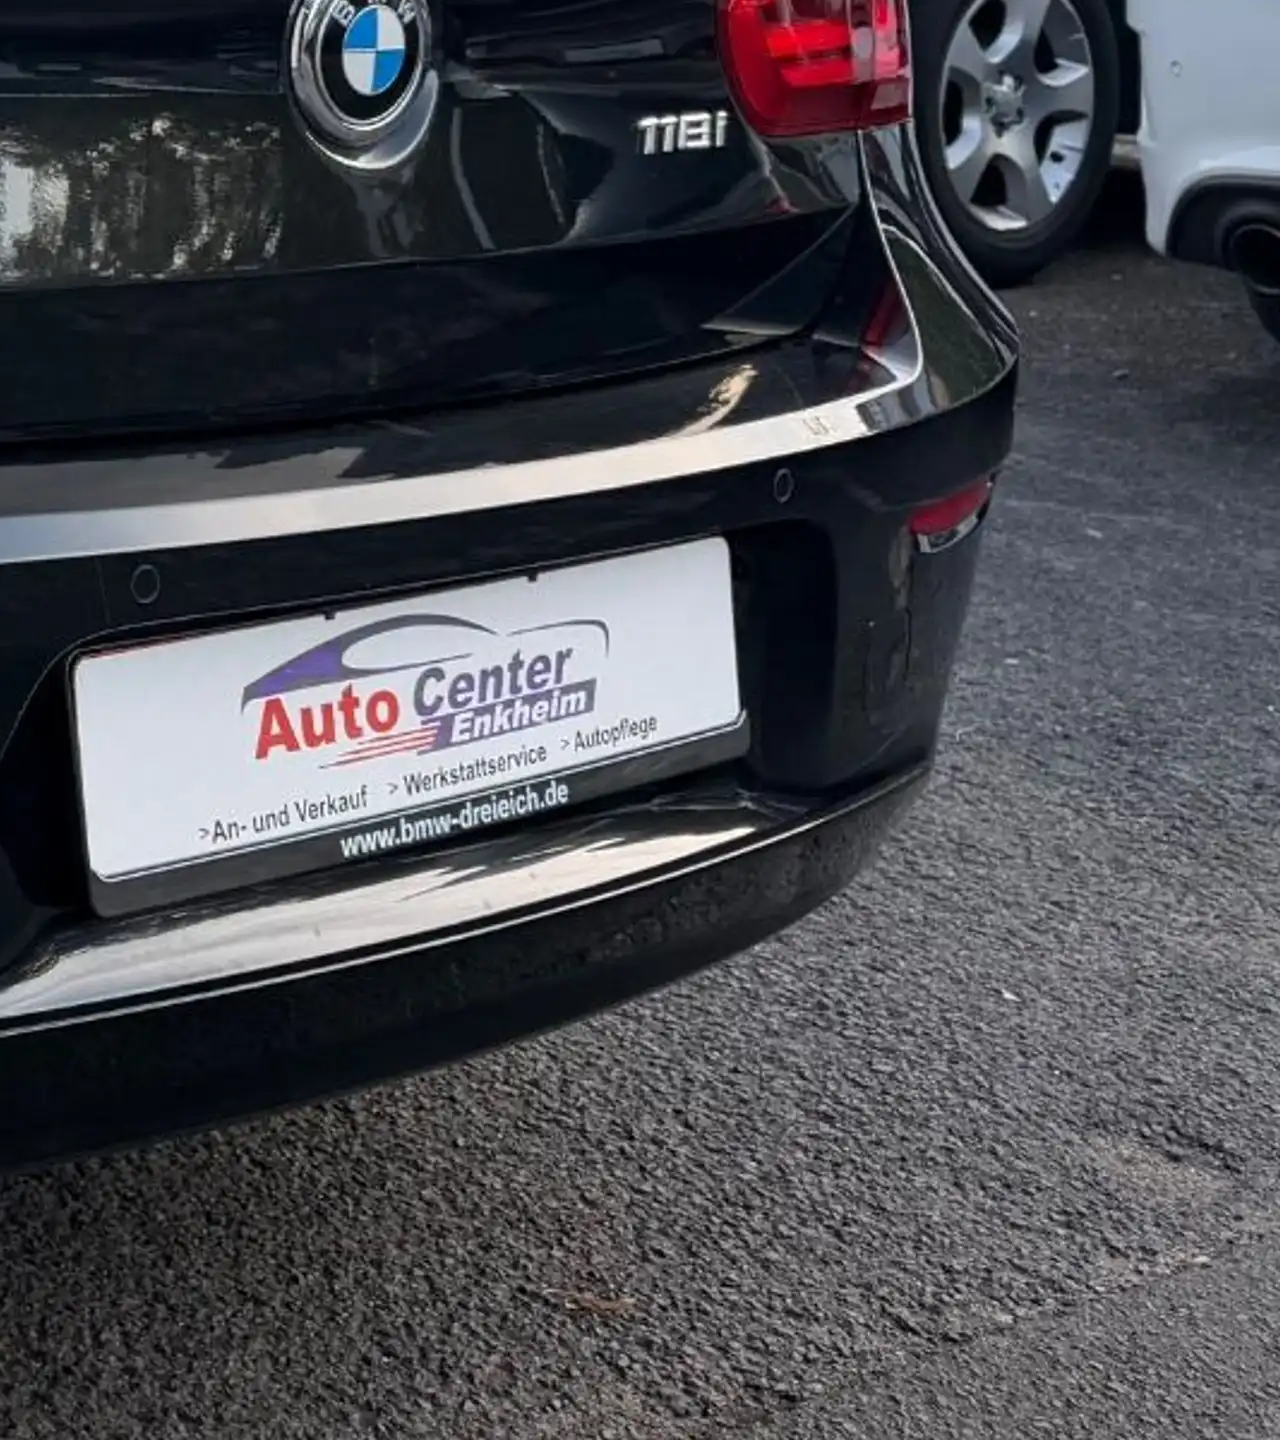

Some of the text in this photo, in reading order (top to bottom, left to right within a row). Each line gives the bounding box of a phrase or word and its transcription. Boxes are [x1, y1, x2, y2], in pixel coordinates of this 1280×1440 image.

[637, 110, 728, 156] 118i
[254, 648, 574, 761] Auto Center
[450, 688, 587, 744] Enkheim
[252, 803, 291, 834] und
[294, 783, 368, 823] Verkauf
[402, 744, 548, 796] Werkstattservice
[573, 714, 659, 753] Autopflege
[340, 779, 570, 859] www.bmw-dreieich.de
